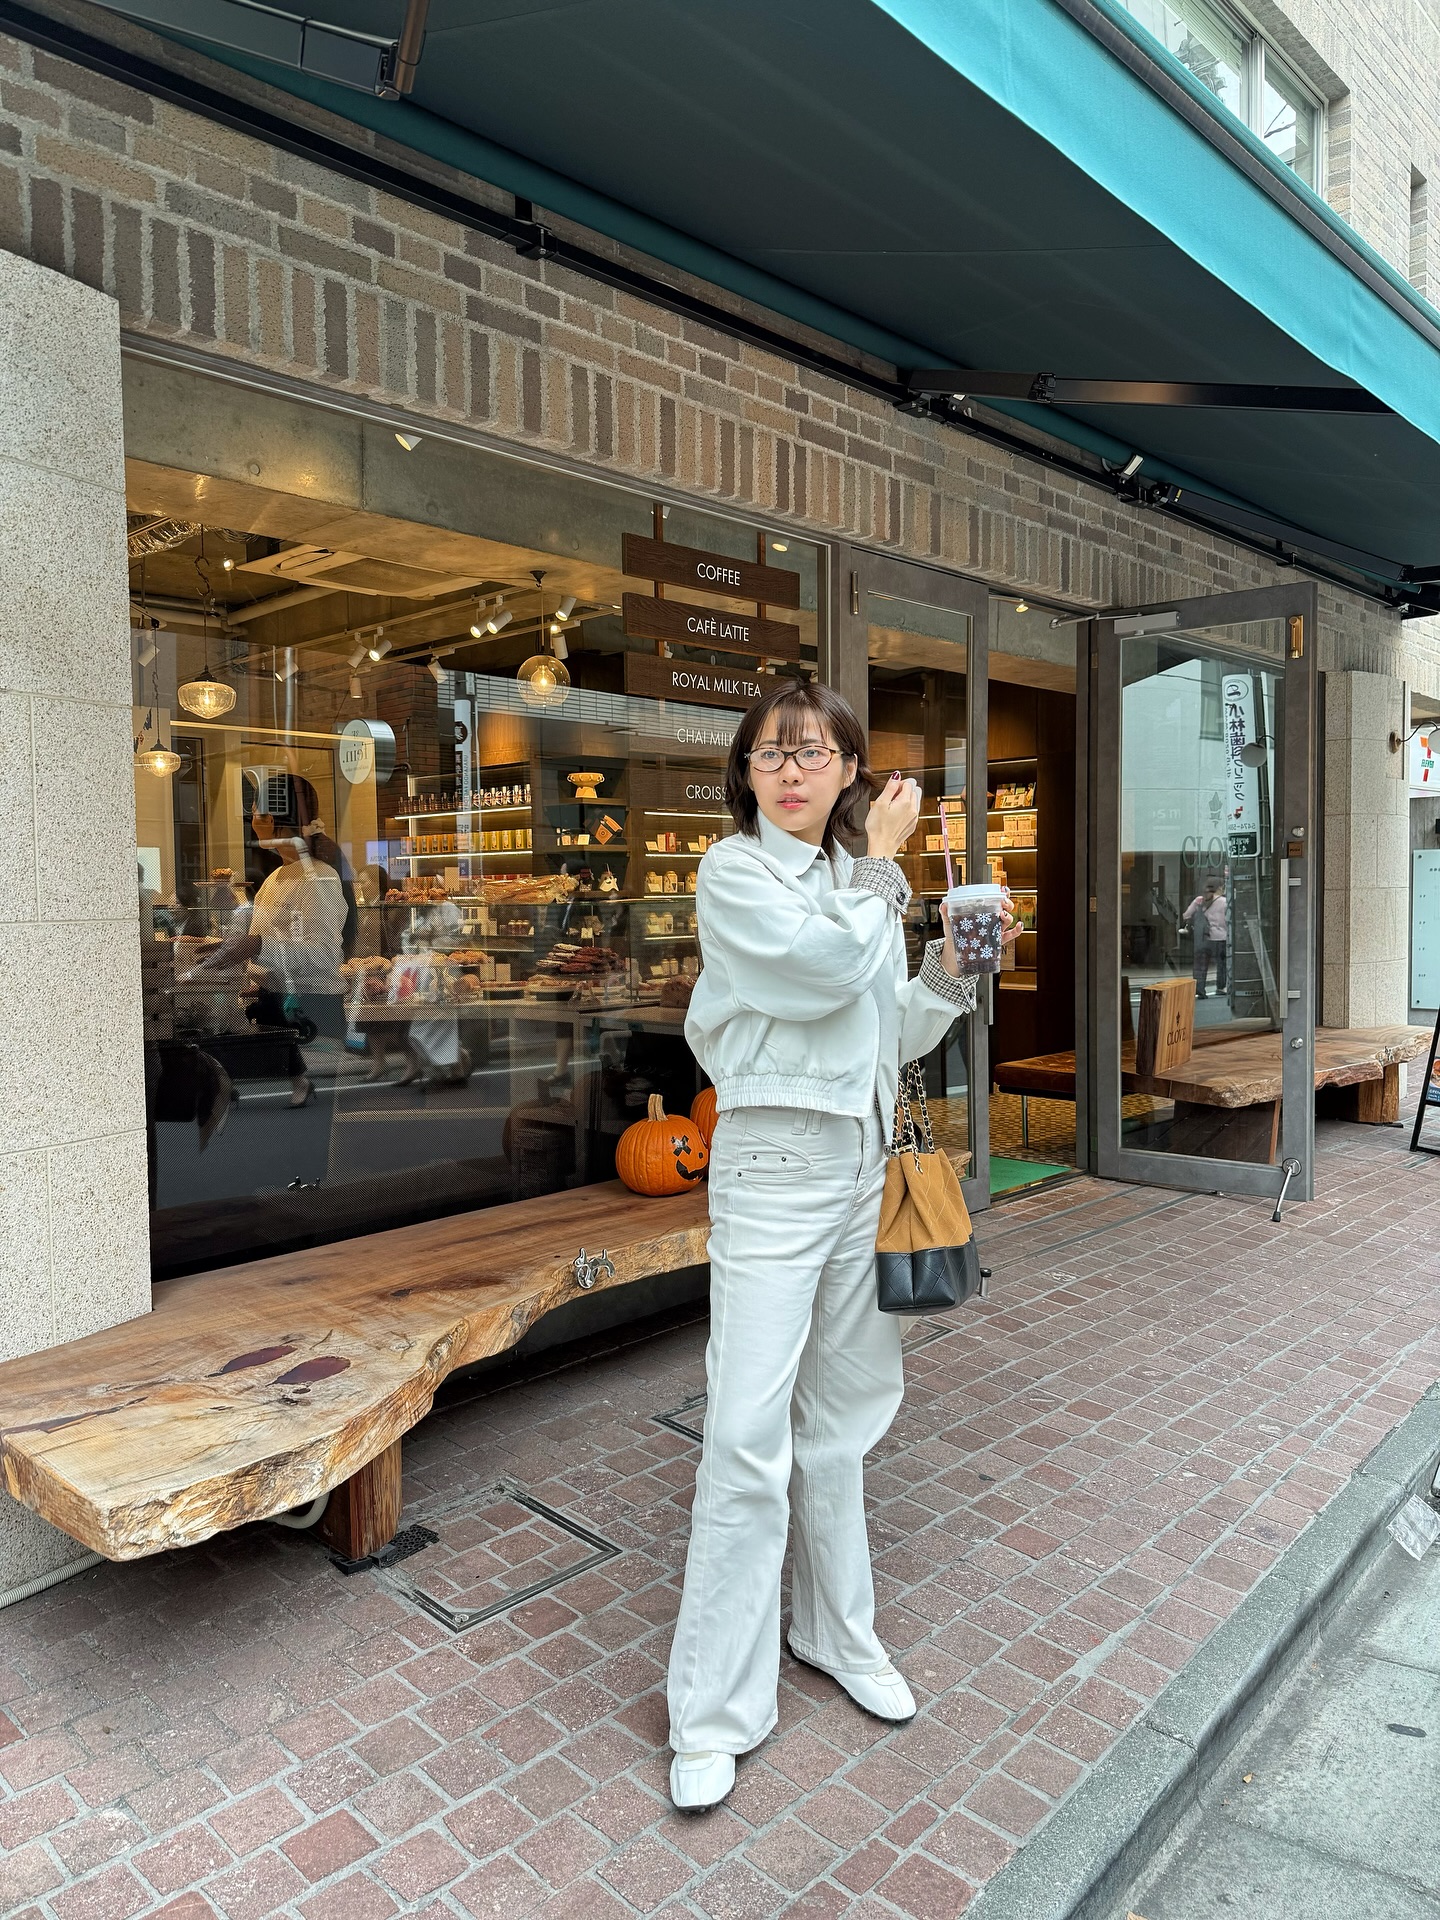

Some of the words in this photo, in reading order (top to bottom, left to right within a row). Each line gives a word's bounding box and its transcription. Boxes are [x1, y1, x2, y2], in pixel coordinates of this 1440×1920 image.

[697, 563, 741, 586] COFFEE
[687, 617, 717, 636] CAFÈ
[720, 622, 750, 642] LATTE
[672, 671, 711, 691] ROYAL
[713, 677, 740, 695] MILK
[742, 681, 762, 698] TEA
[677, 728, 706, 745] CHAI
[1166, 1027, 1187, 1047] CLOVE
